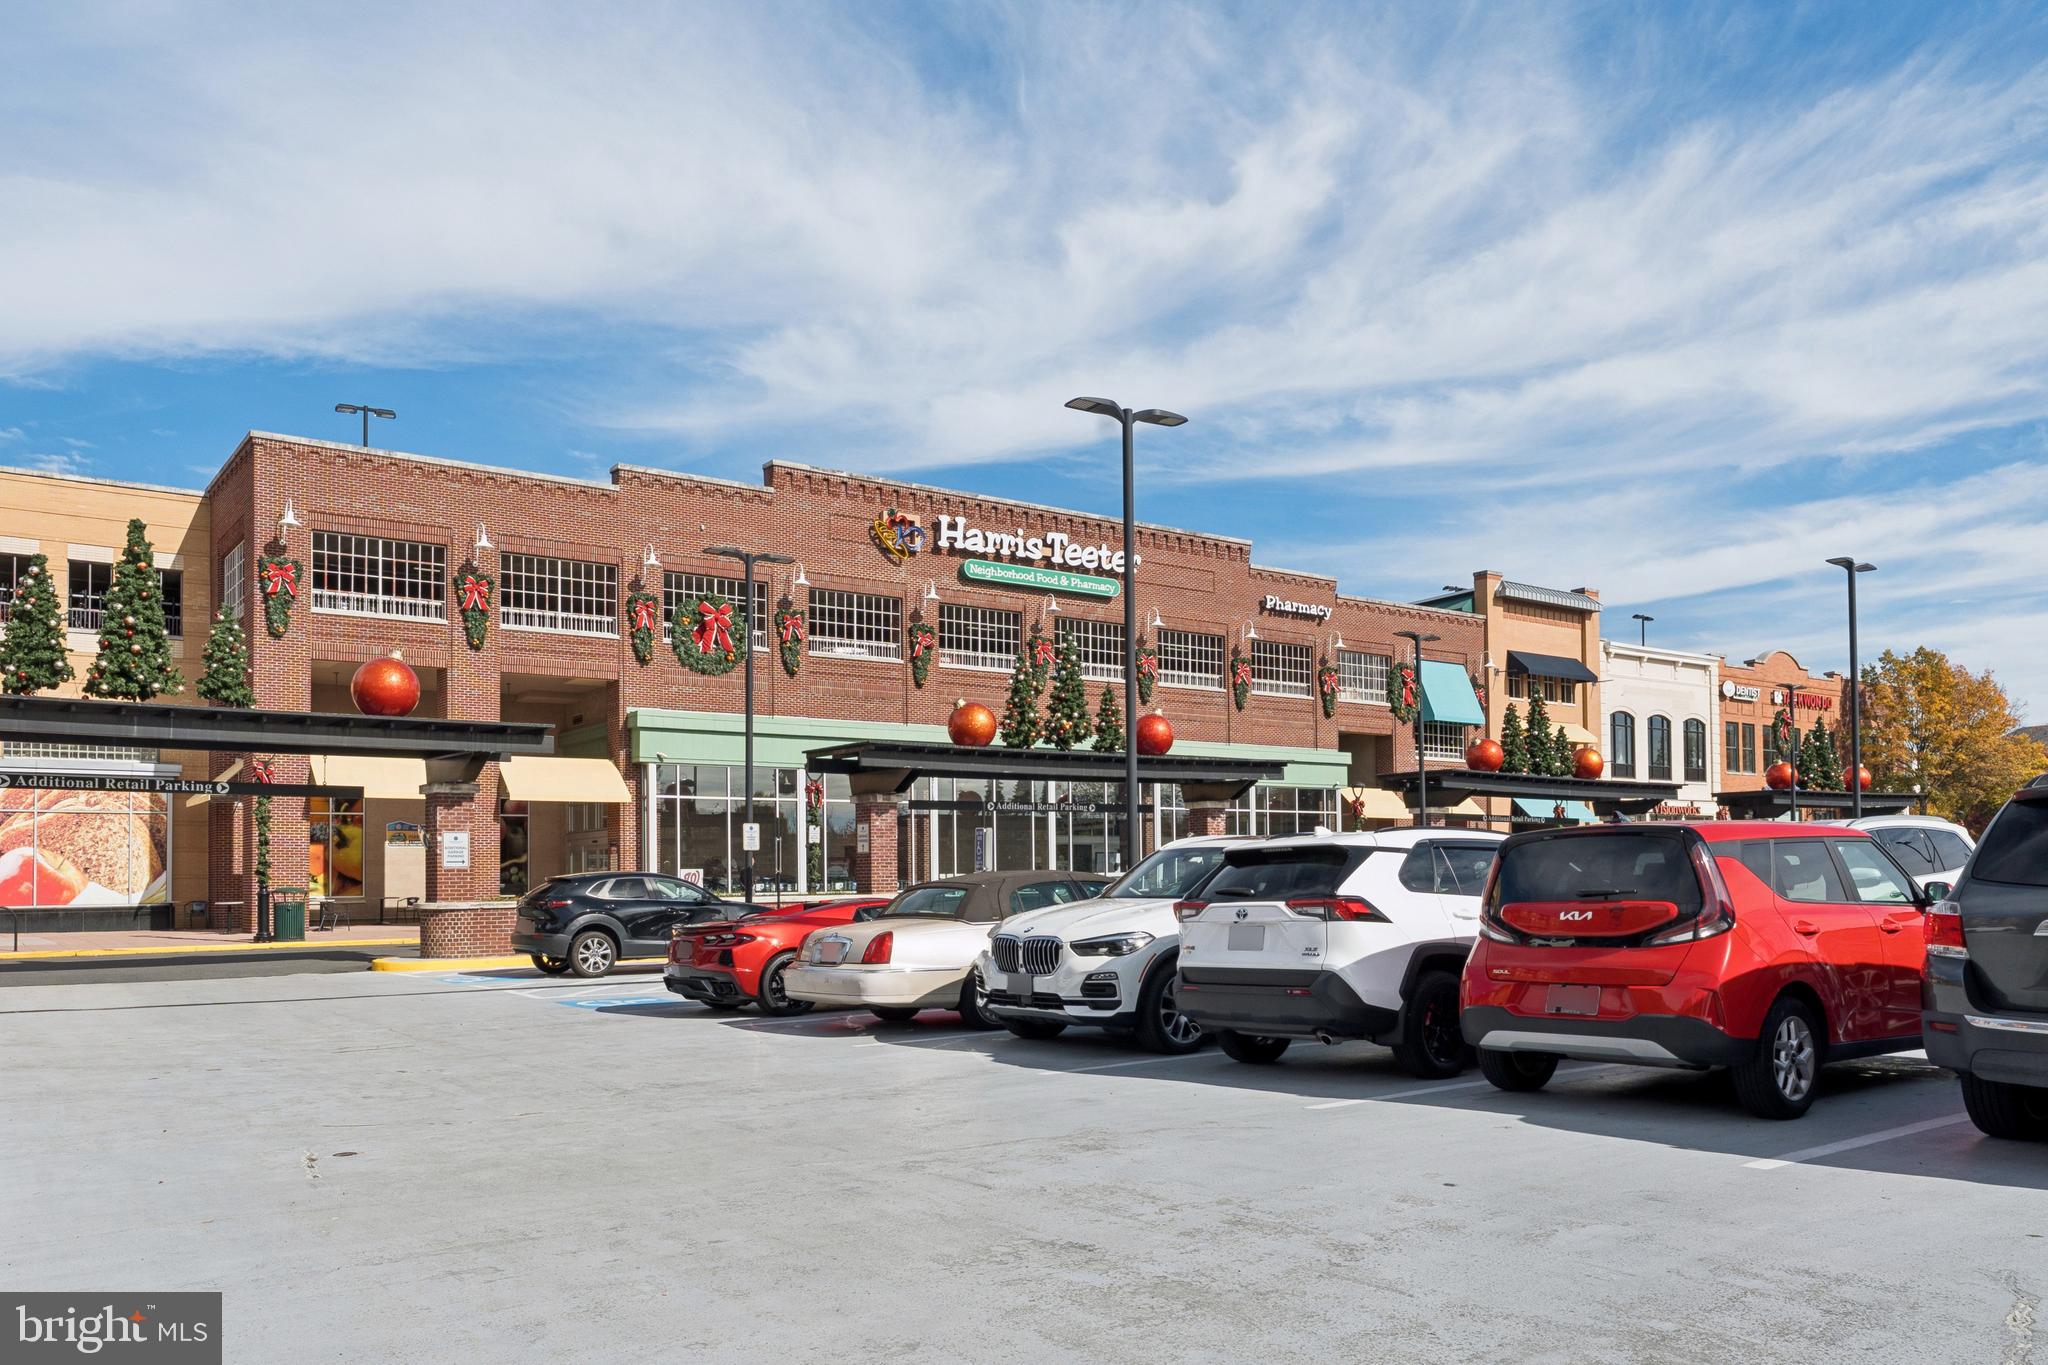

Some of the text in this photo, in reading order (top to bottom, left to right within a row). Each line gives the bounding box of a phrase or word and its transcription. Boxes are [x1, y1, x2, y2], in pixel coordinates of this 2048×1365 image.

[937, 515, 1043, 560] Harris
[969, 563, 1117, 595] Neighborhood Food & Pharmacy
[1265, 595, 1332, 621] Pharmacy
[1736, 686, 1760, 697] DENTIST
[15, 775, 213, 794] Additional Retail Parking
[996, 803, 1088, 812] Additional Retail Parking
[1559, 911, 1593, 921] KIA
